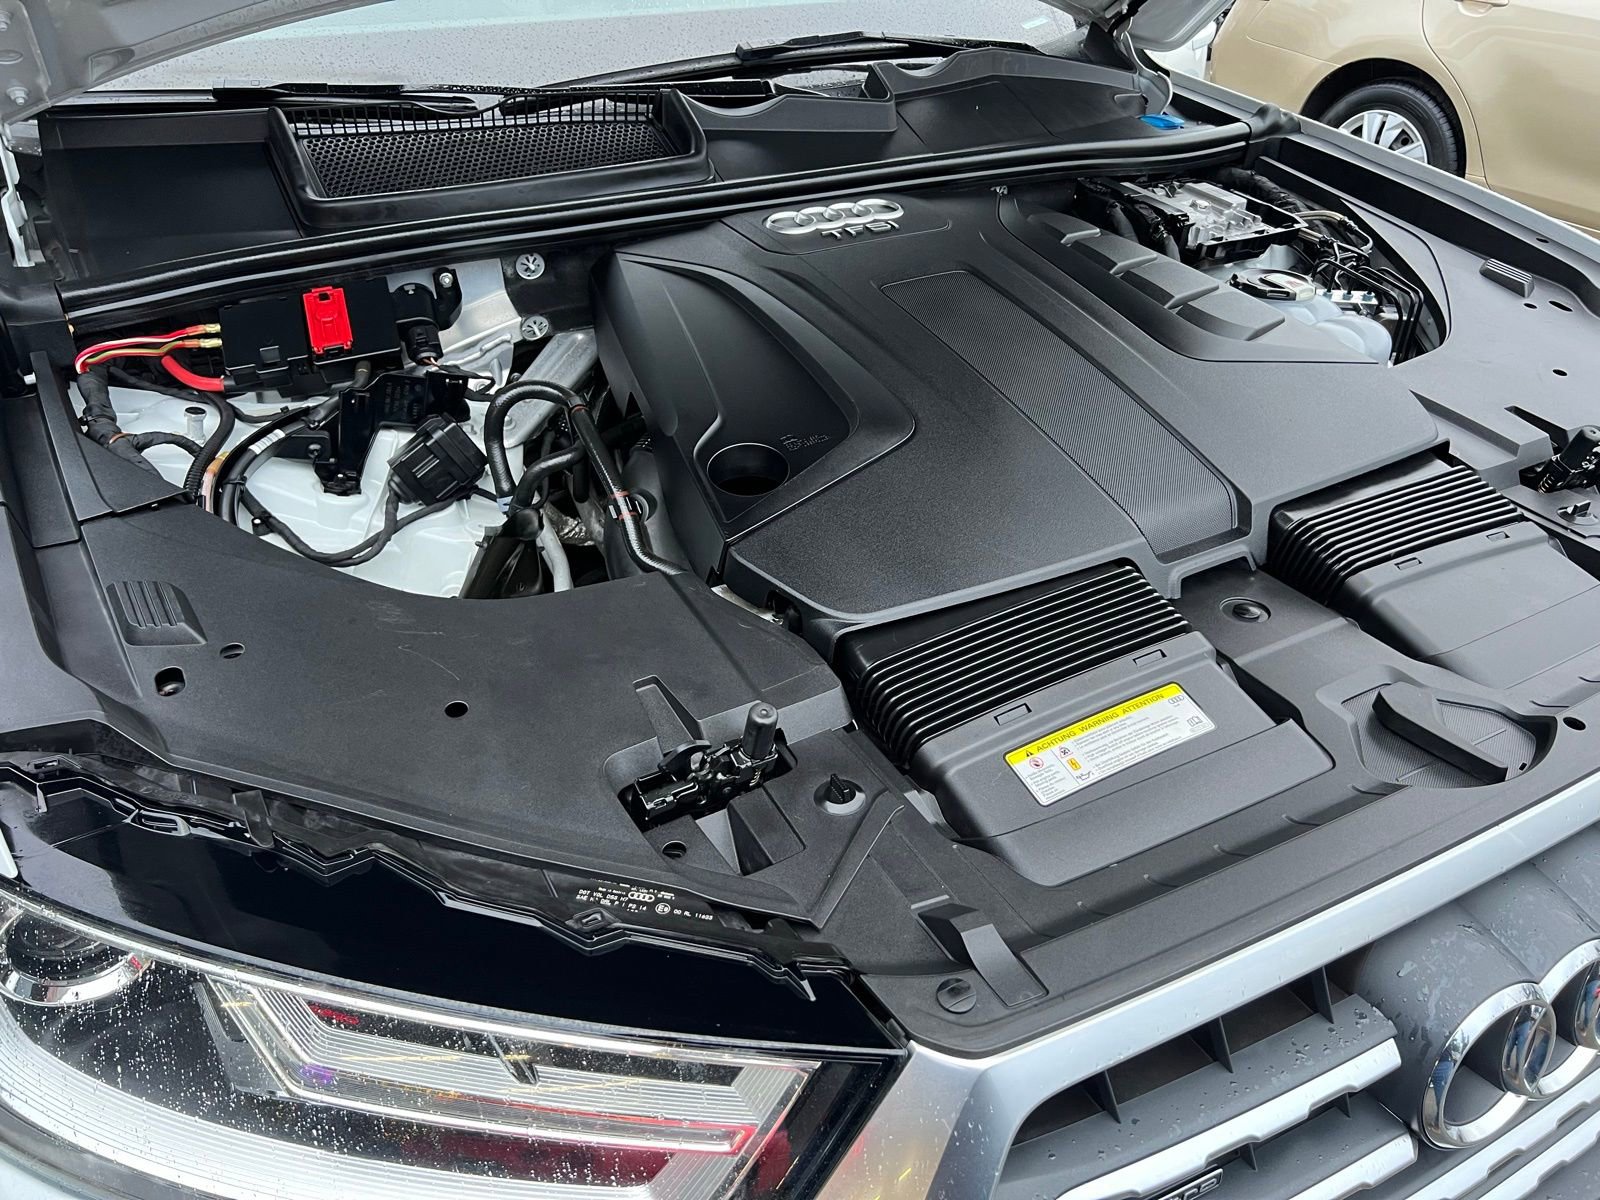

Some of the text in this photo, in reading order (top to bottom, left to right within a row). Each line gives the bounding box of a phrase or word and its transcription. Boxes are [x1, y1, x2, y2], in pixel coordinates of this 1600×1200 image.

[821, 220, 900, 239] TFSI
[1036, 731, 1076, 752] ACHTUNG
[1079, 712, 1119, 732] WARNING
[1122, 693, 1164, 714] ATTENTION
